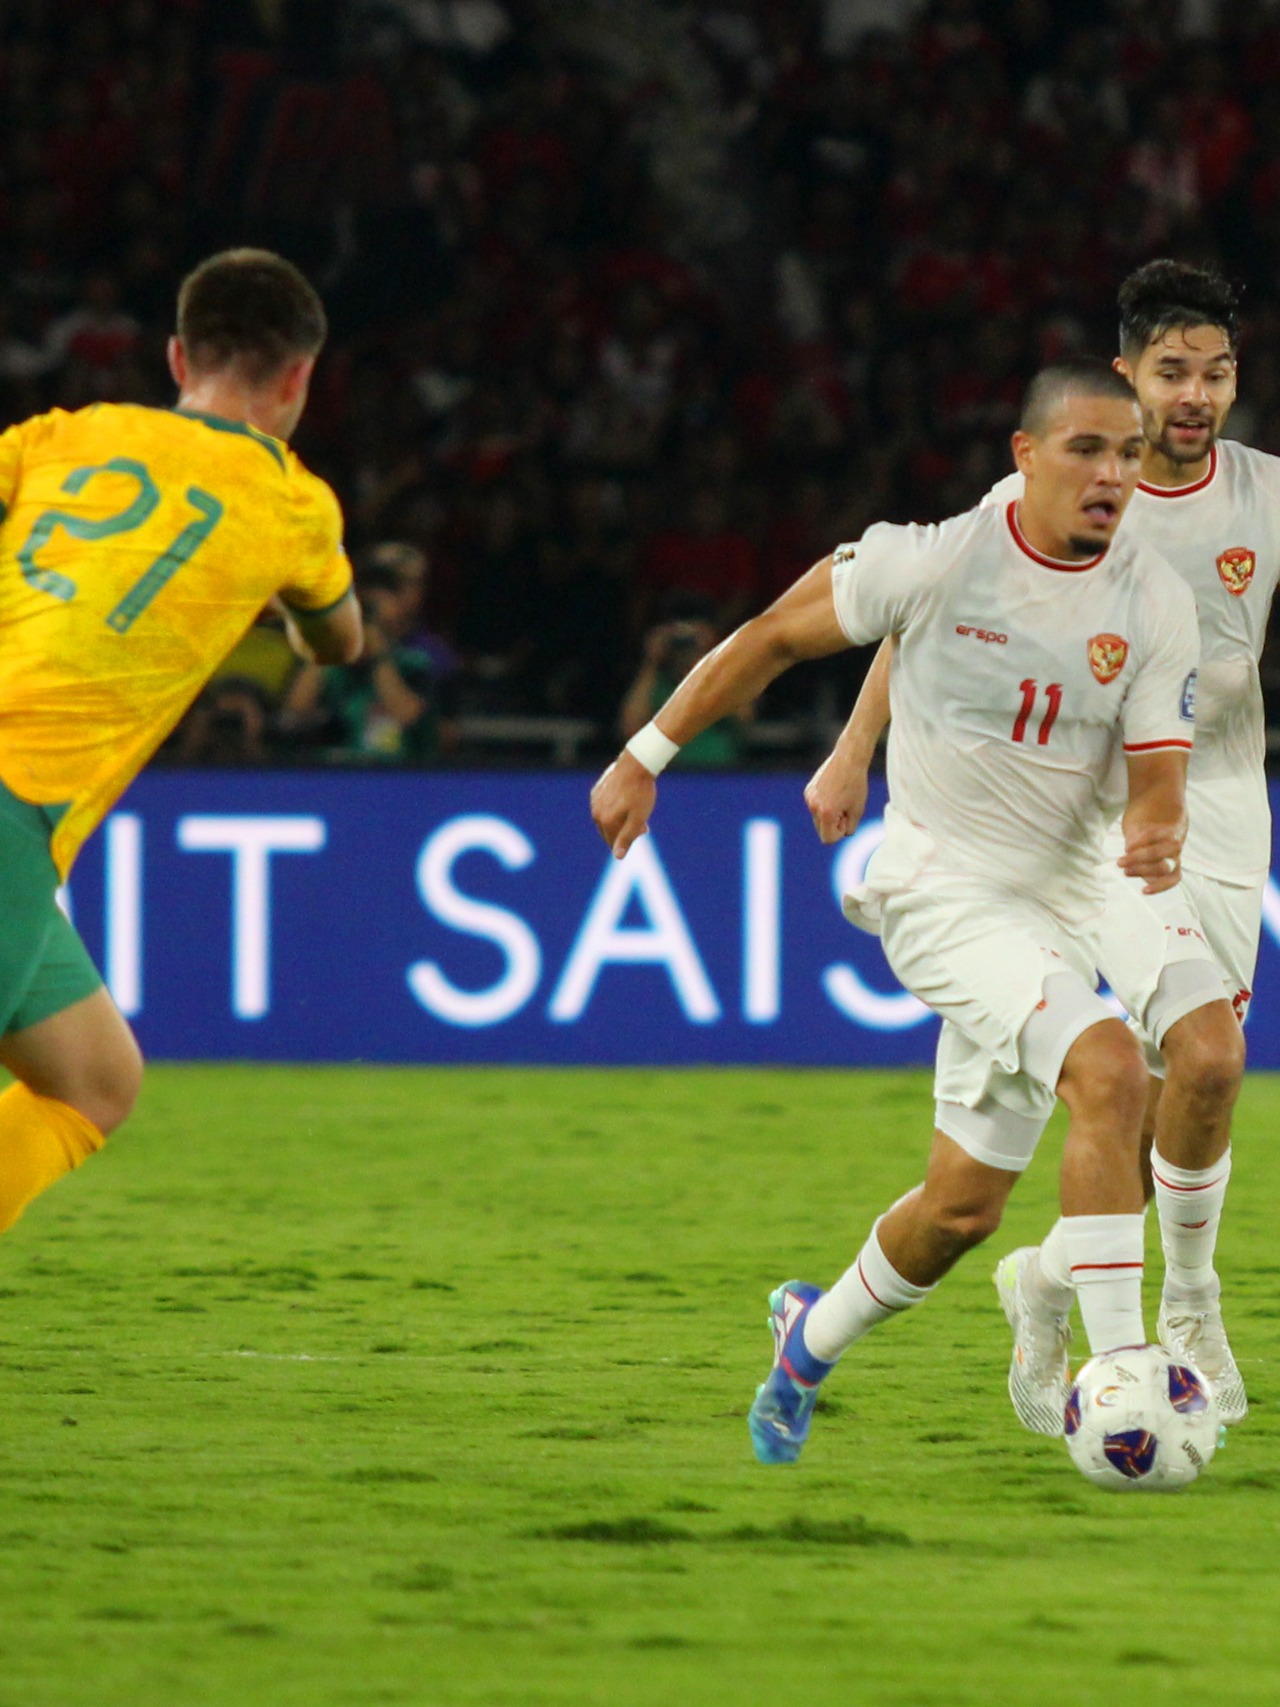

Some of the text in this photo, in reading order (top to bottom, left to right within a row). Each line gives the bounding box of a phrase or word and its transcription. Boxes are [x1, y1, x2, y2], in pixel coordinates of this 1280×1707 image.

[16, 457, 224, 634] 21
[955, 624, 1008, 644] erspo
[1011, 678, 1063, 746] 11
[57, 815, 327, 1019] IT
